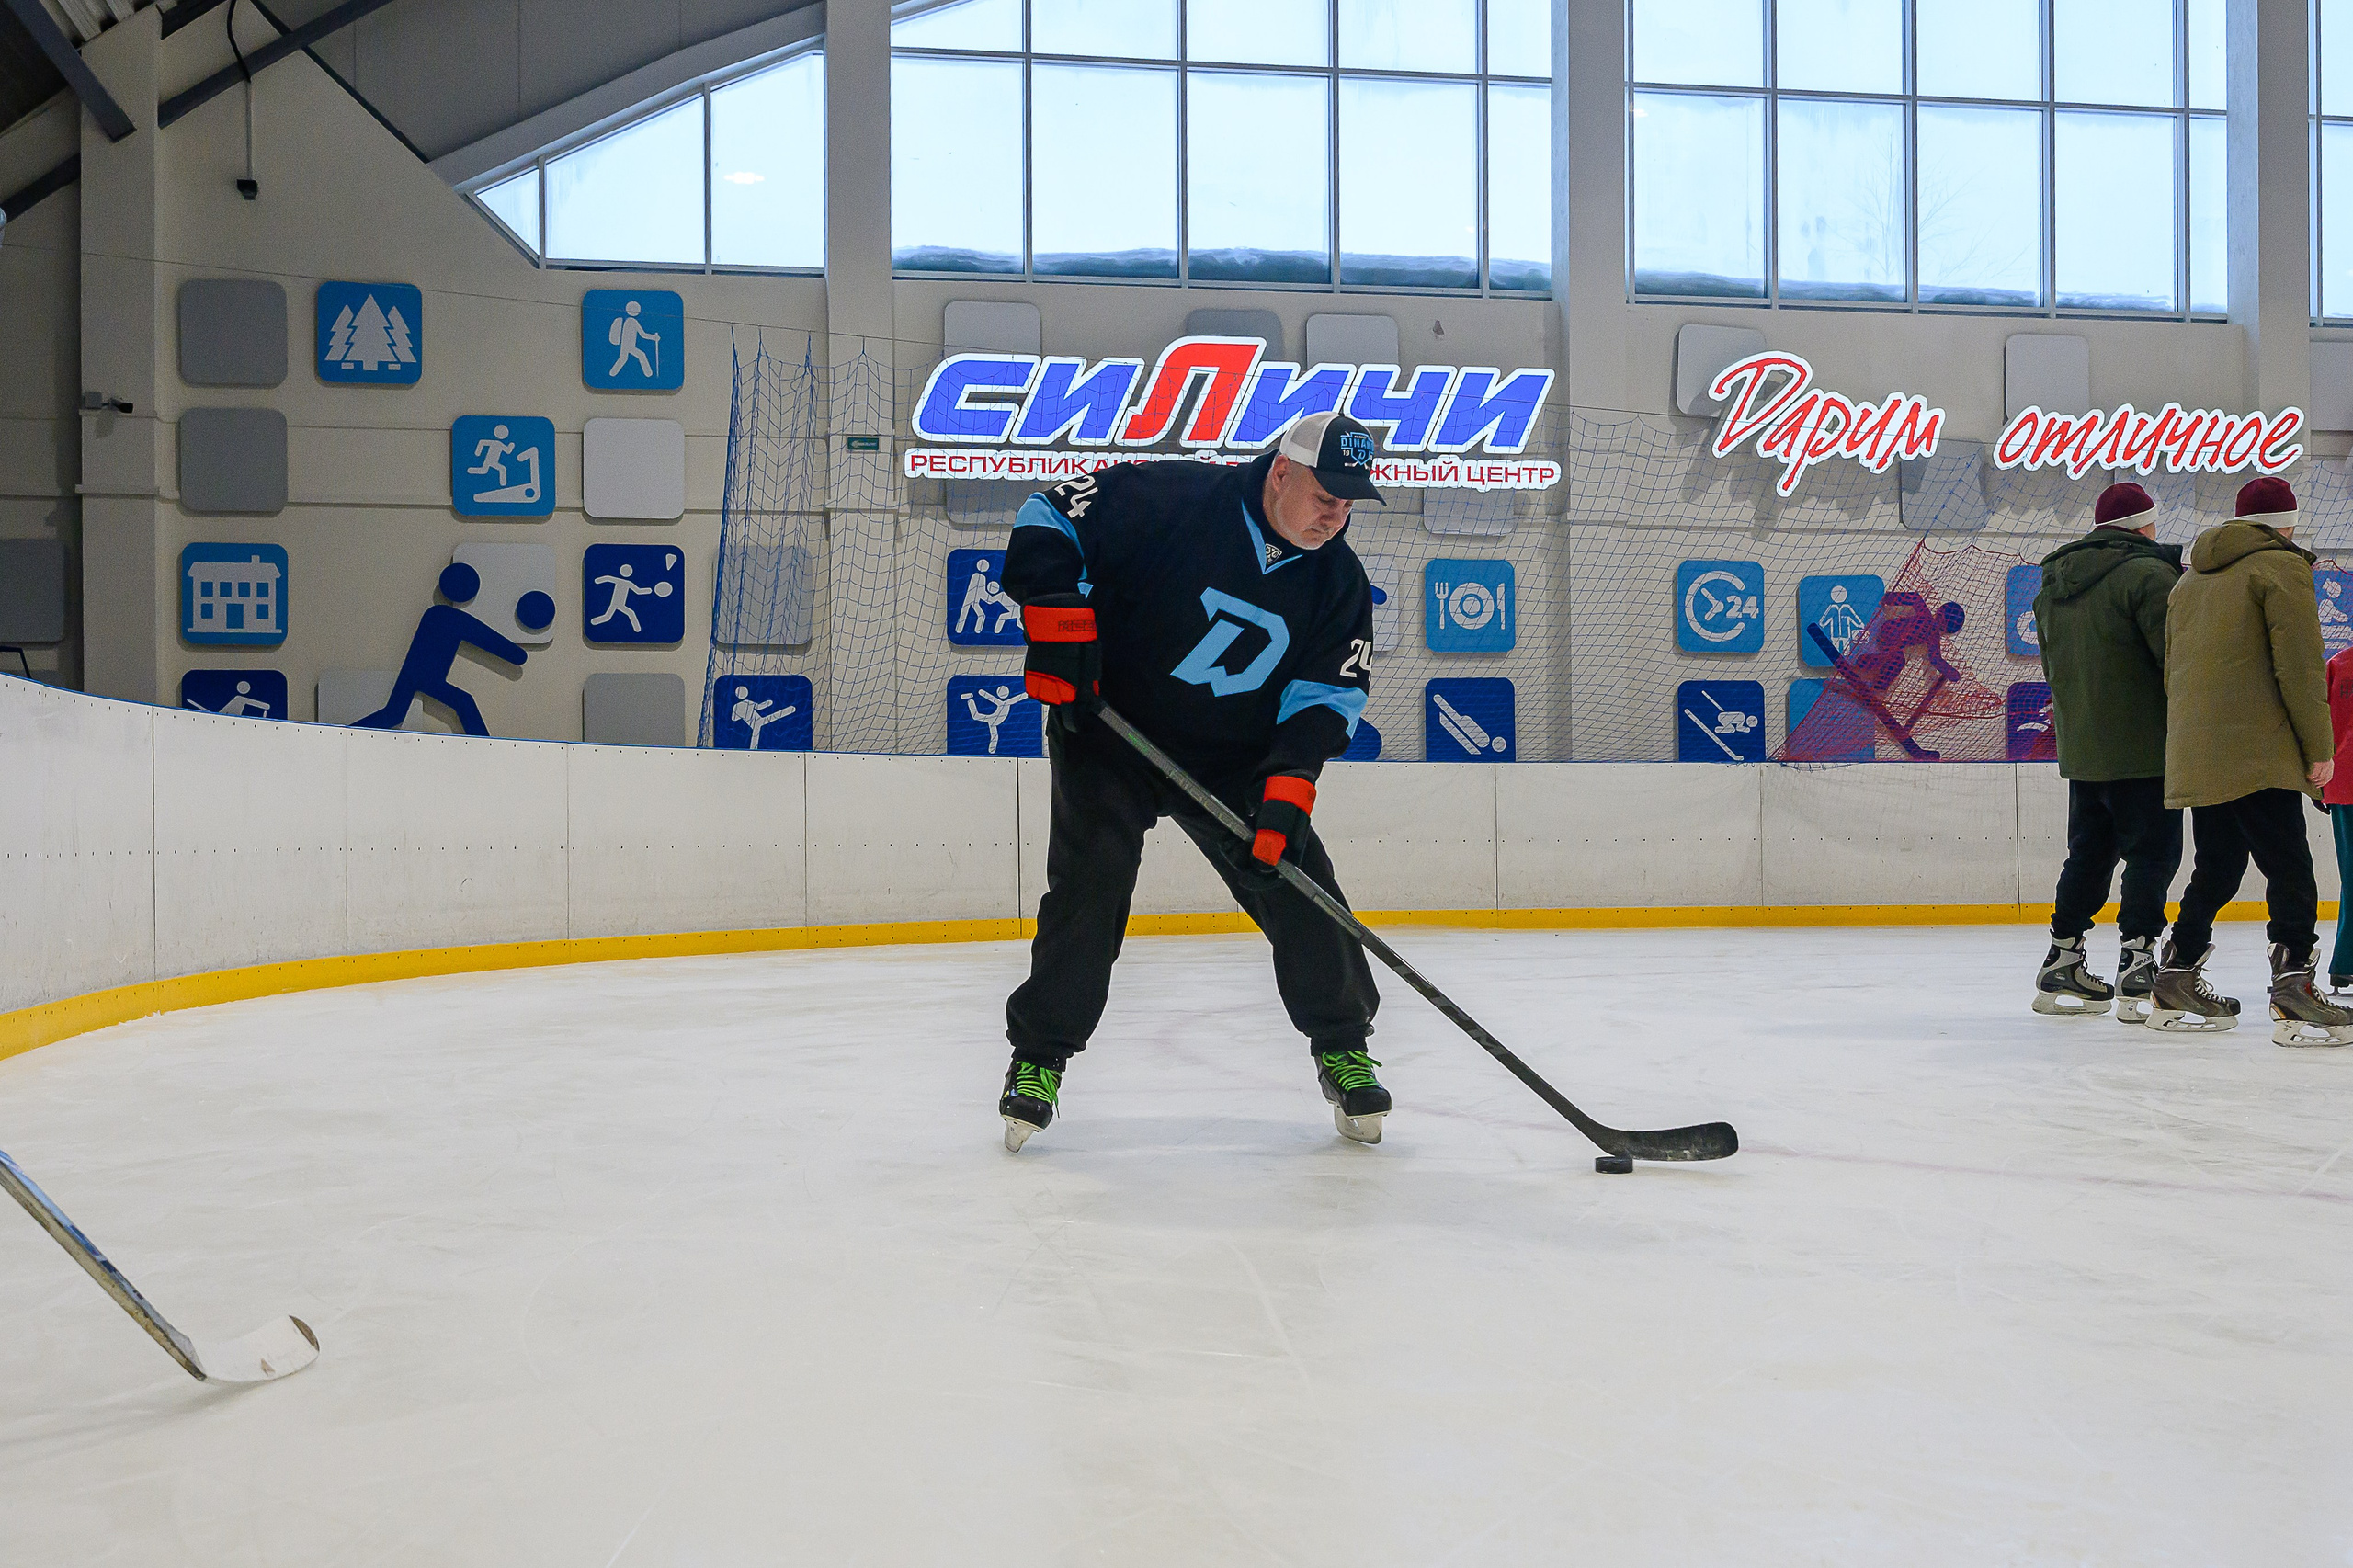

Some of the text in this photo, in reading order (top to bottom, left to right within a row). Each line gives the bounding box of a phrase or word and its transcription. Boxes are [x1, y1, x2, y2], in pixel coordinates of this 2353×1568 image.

[1711, 354, 2302, 494] Дарим отличное
[1054, 474, 1098, 518] 24
[1467, 466, 1555, 485] ЦЕНТР
[1726, 595, 1759, 619] 24
[1339, 638, 1373, 681] 24
